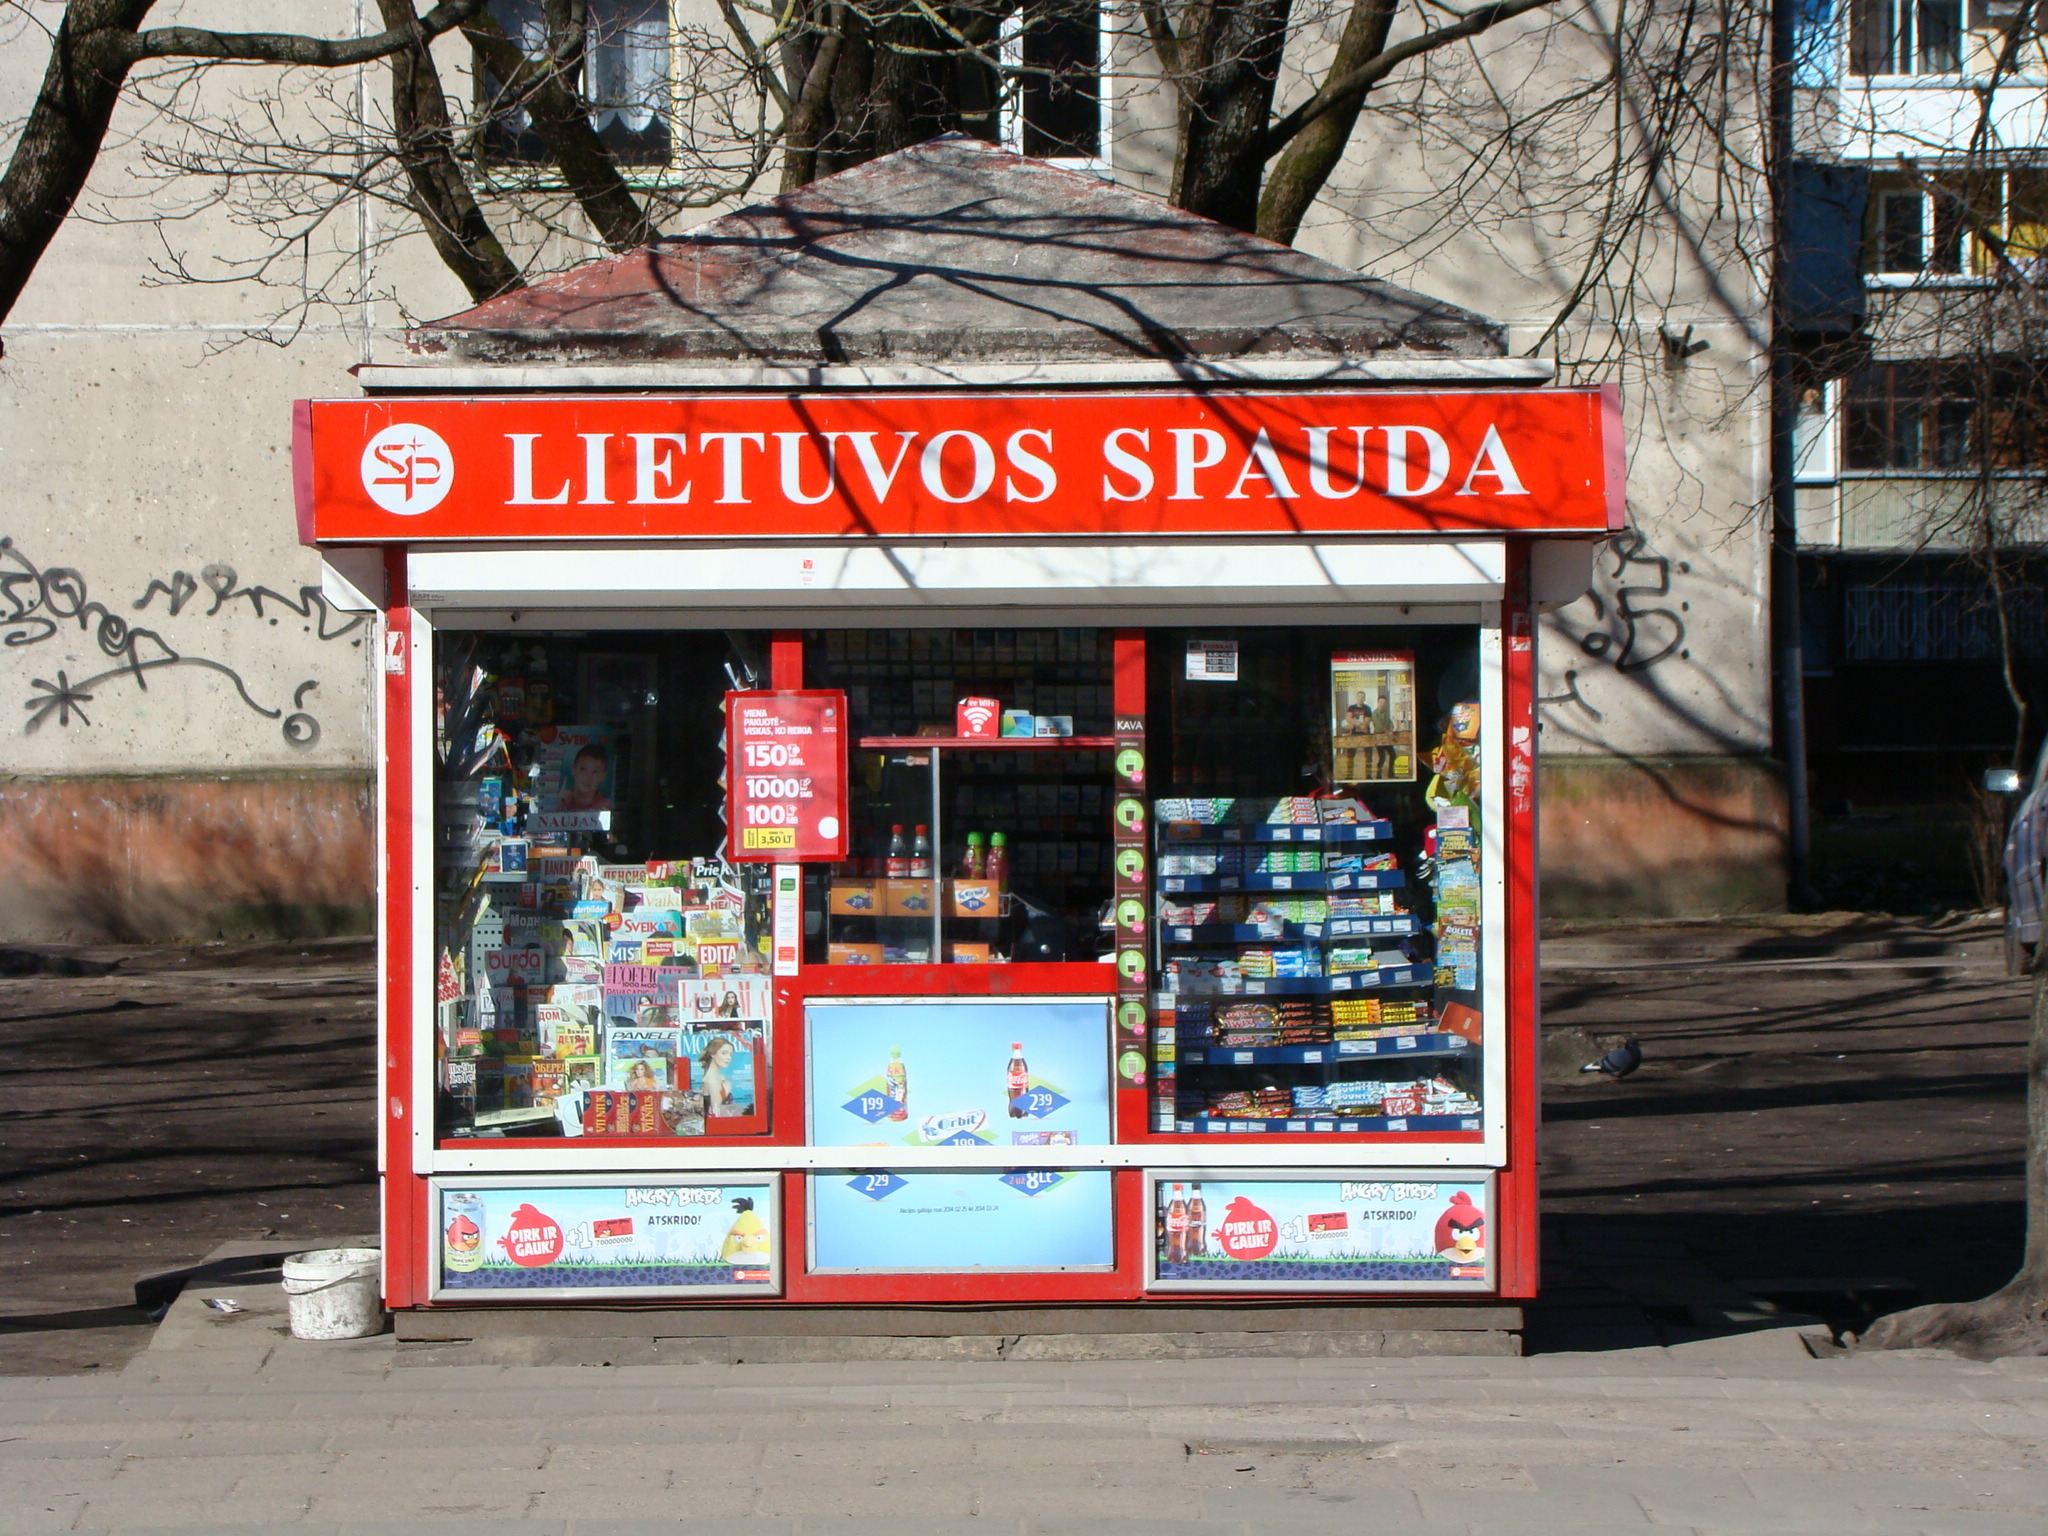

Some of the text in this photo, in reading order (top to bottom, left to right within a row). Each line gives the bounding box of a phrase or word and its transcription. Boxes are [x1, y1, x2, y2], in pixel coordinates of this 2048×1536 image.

[503, 421, 1532, 505] LIETUVOS SPAUDA
[744, 709, 767, 717] VIENA
[744, 716, 778, 726] PAKUOTĖ
[744, 727, 812, 736] VISKAS, KO REIKIA
[1117, 720, 1143, 731] KAVA
[745, 745, 788, 767] 150
[746, 779, 799, 799] 1000
[746, 805, 785, 825] 100
[761, 835, 782, 845] 3,50
[783, 835, 793, 844] LT
[701, 945, 736, 964] EDITA
[861, 1097, 884, 1115] 199
[1028, 1093, 1054, 1111] 239
[937, 1114, 978, 1130] Orbit
[865, 1173, 890, 1191] 229
[625, 1188, 723, 1208] ANGRY BIRDS
[1340, 1183, 1438, 1202] ANGRY BIRDS
[648, 1215, 702, 1226] ATSKRIDO!
[1363, 1210, 1417, 1221] ATSKRIDO!
[510, 1226, 558, 1243] PIRK IR
[566, 1221, 593, 1249] +1
[1225, 1219, 1272, 1237] PIRK IR
[1281, 1215, 1307, 1243] +1
[515, 1240, 555, 1257] GAUK!
[1230, 1233, 1269, 1250] GAUK!
